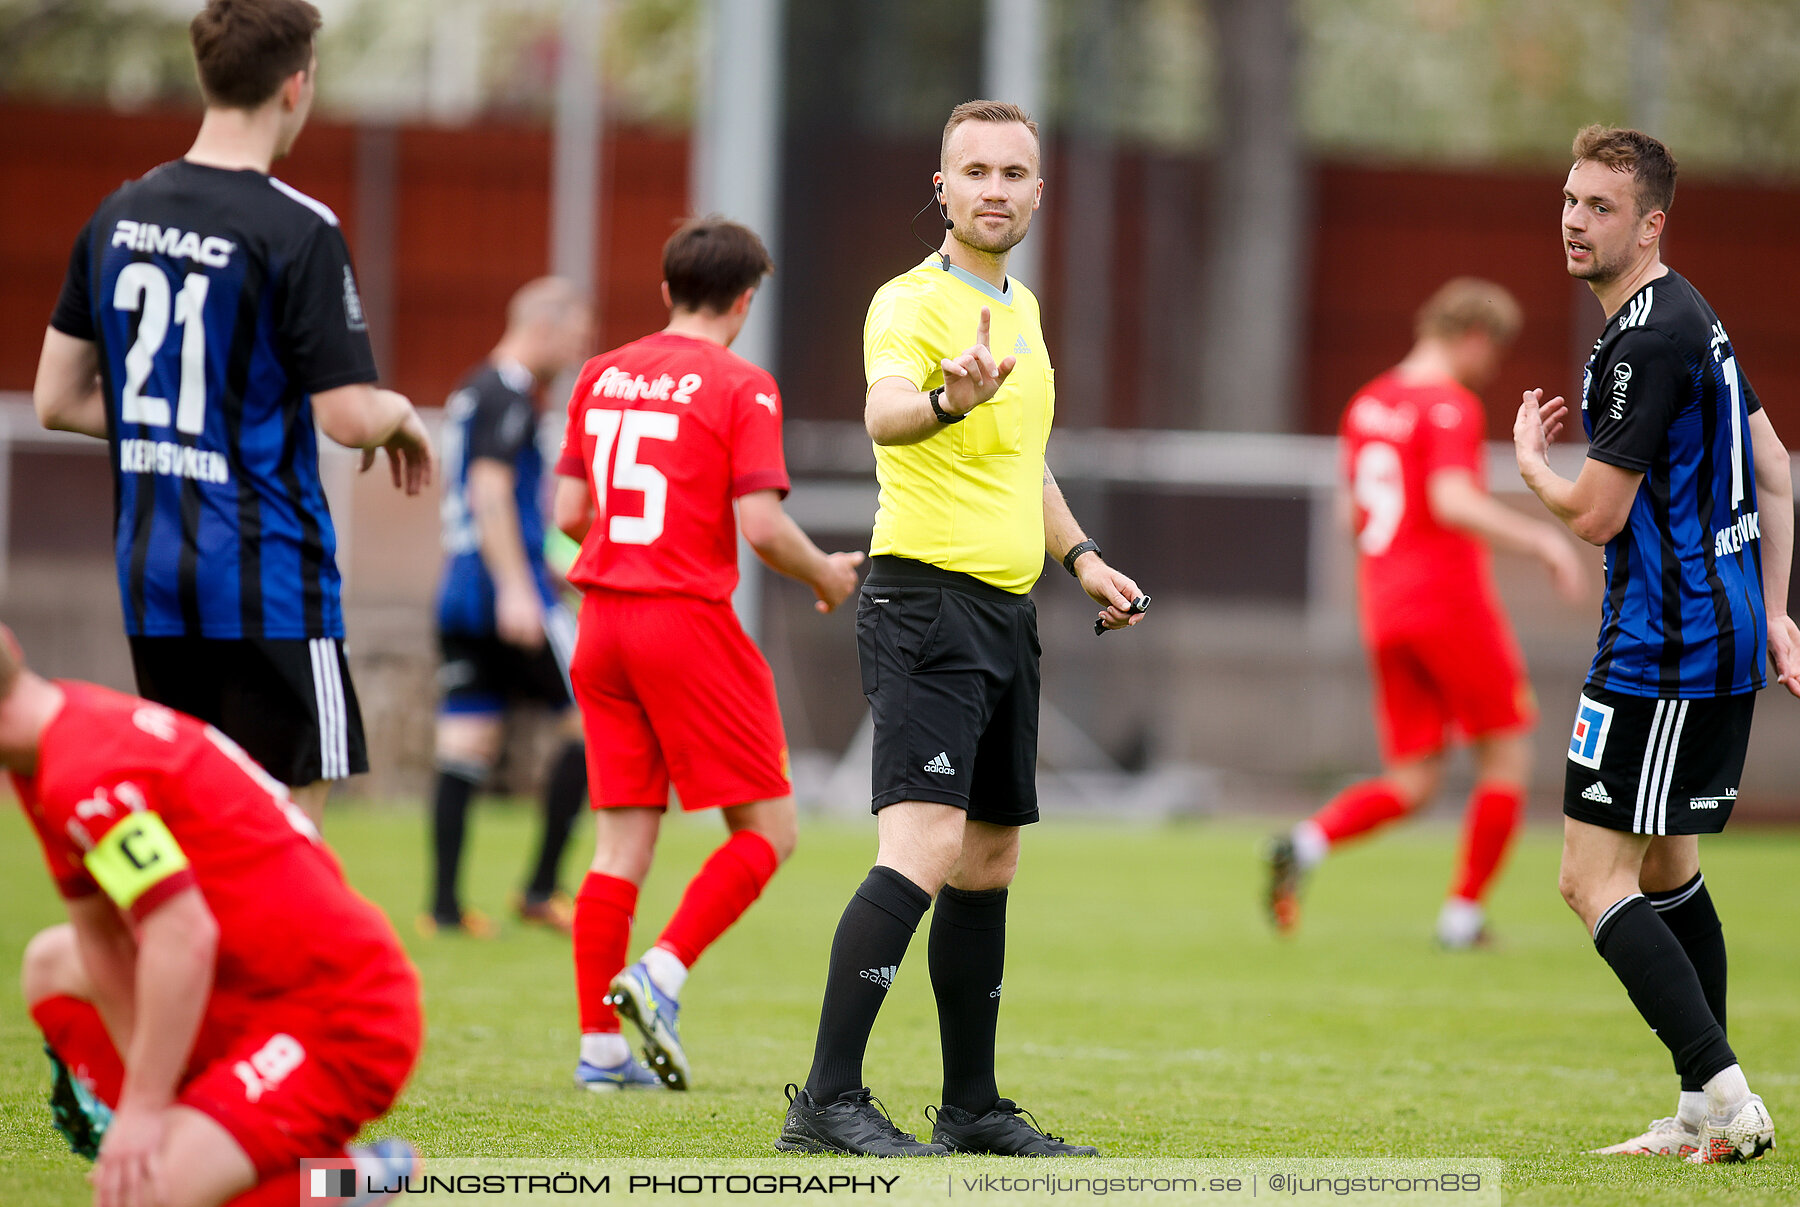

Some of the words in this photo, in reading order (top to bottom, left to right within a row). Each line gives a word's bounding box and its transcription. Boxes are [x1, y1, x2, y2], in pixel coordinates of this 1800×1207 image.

[113, 262, 210, 436] 21
[1609, 362, 1632, 420] PRIMA
[923, 764, 956, 776] adidas
[1581, 791, 1613, 805] adidas
[1689, 800, 1719, 810] DAVID
[119, 827, 159, 870] C
